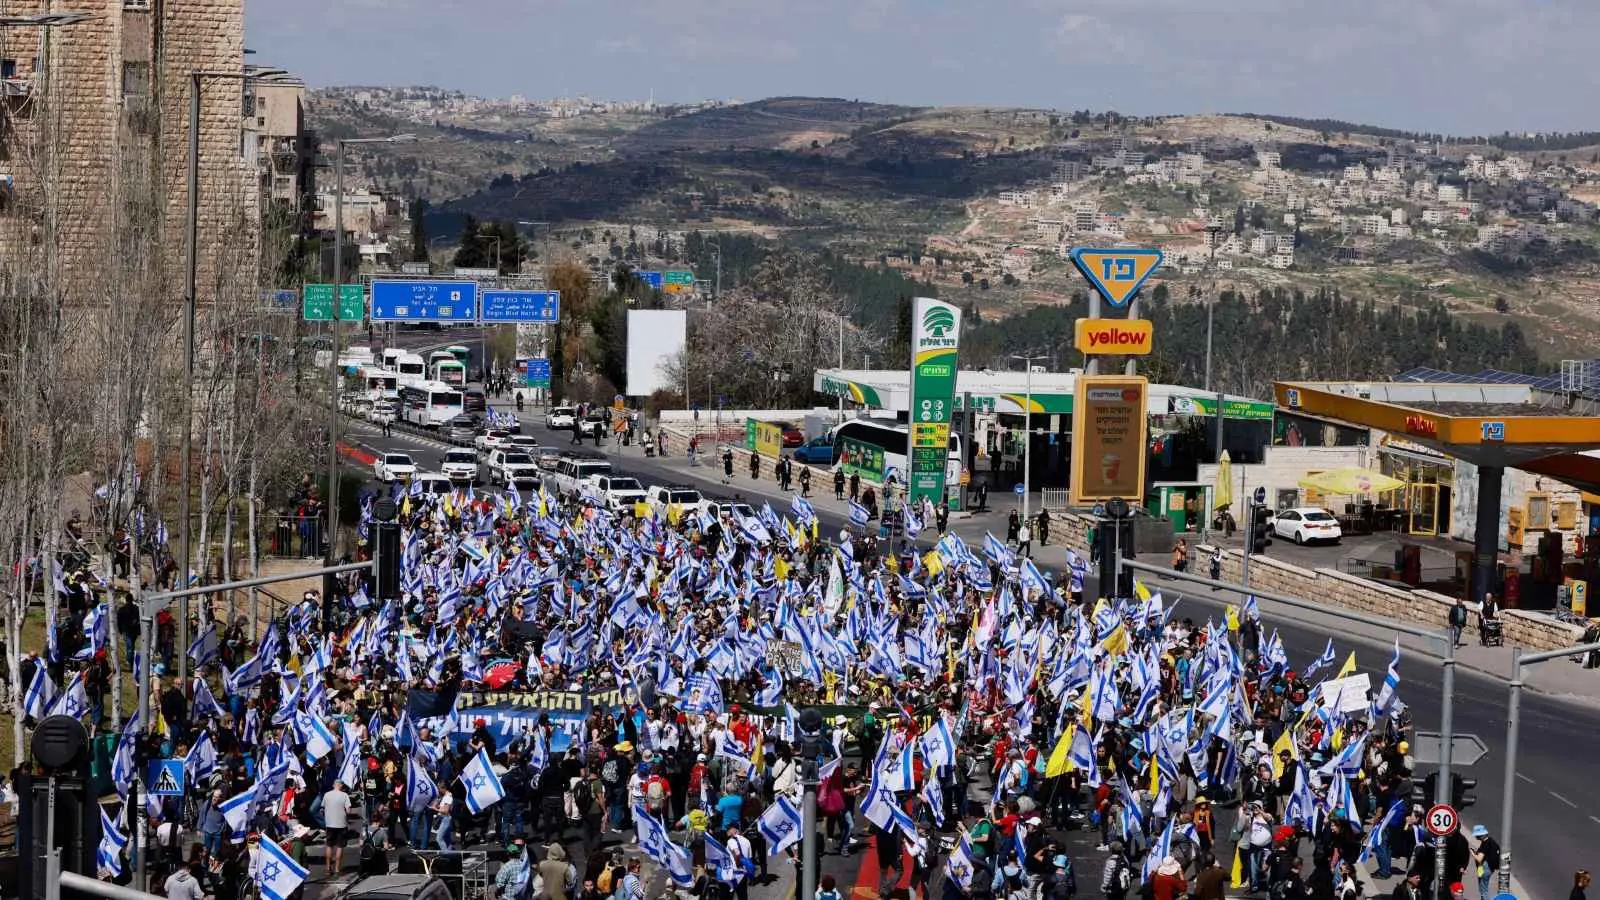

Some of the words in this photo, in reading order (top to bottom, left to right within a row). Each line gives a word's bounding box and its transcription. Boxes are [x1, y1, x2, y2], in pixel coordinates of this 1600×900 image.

[1102, 258, 1136, 281] פז
[1087, 328, 1147, 347] yellow
[1481, 421, 1504, 440] פז
[767, 639, 786, 653] WE
[766, 652, 801, 669] PEOPLE
[458, 690, 582, 710] הקואליצה
[497, 712, 534, 735] של
[1432, 814, 1452, 827] 30
